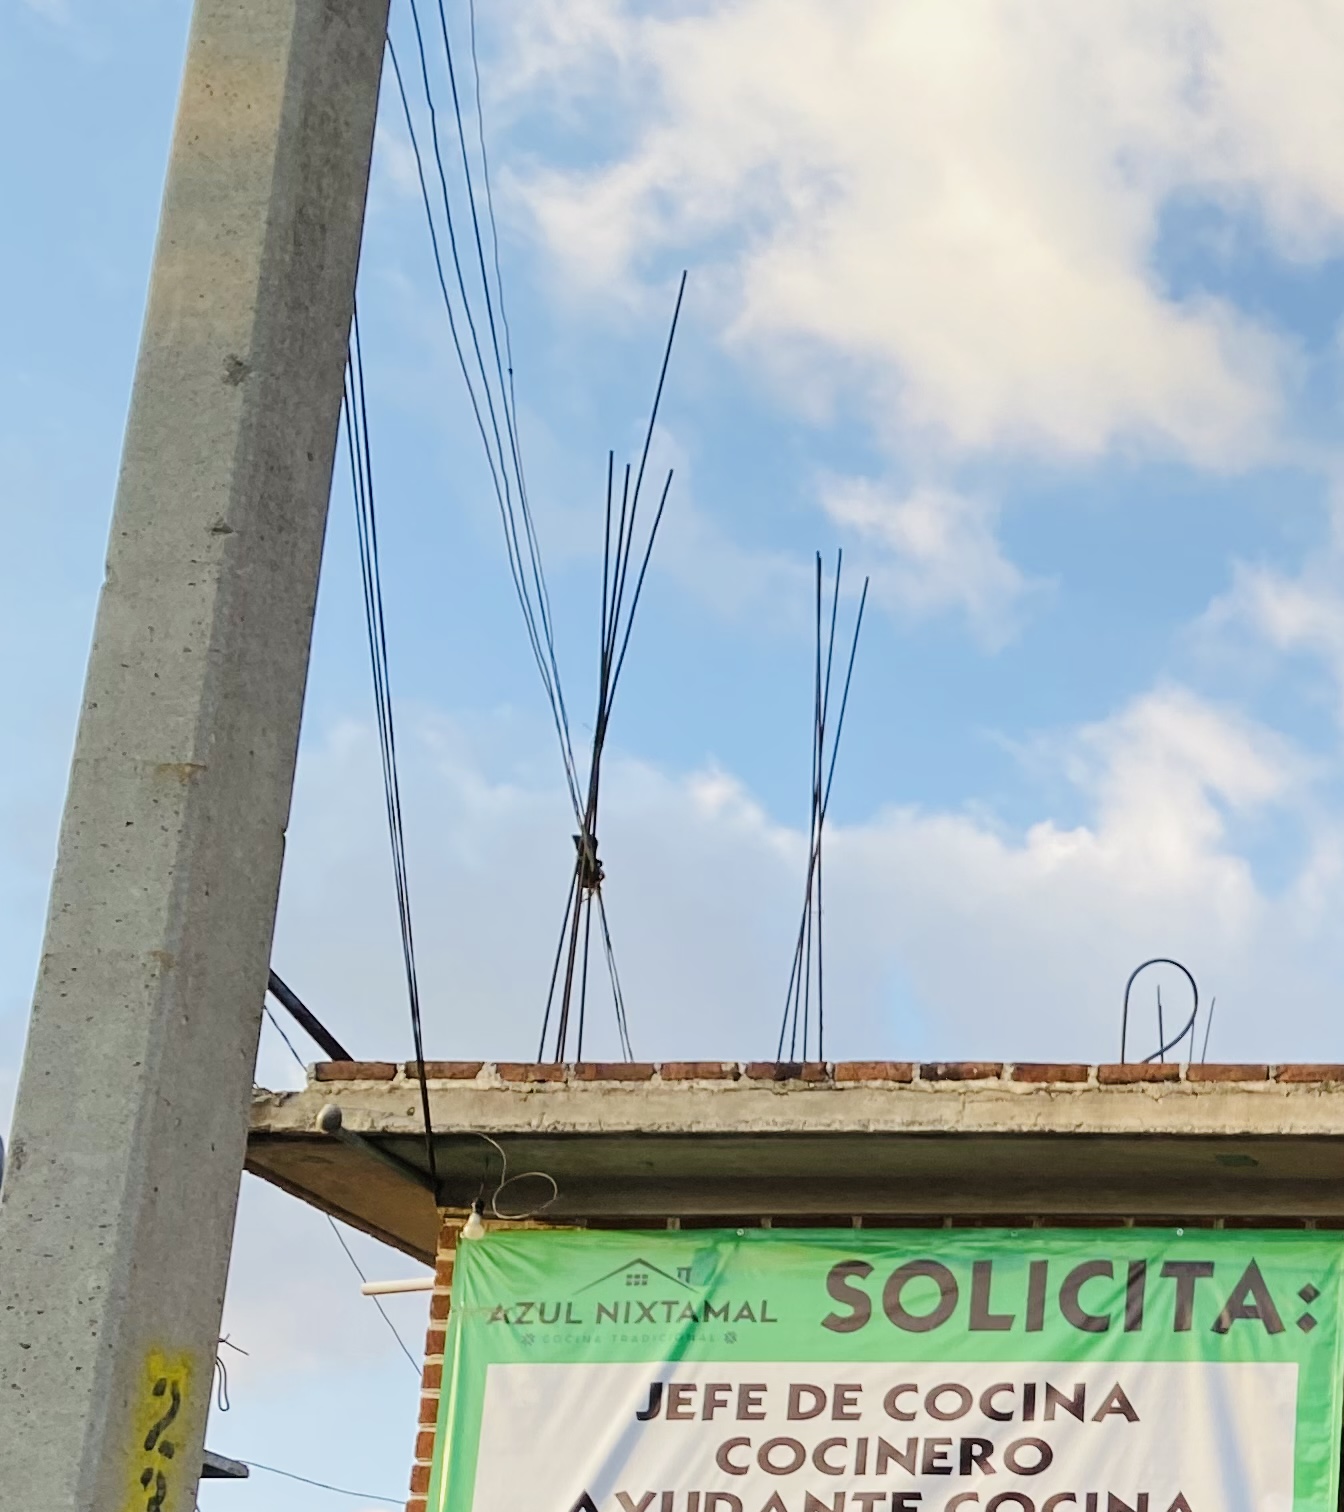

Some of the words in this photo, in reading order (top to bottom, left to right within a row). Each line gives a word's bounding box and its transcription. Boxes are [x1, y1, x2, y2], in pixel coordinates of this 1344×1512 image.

[486, 1301, 583, 1325] AZUL
[596, 1300, 778, 1325] NIXTAMAL
[821, 1258, 1322, 1335] SOLICITA:
[635, 1383, 768, 1421] JEFE
[786, 1383, 863, 1421] DE
[882, 1382, 1141, 1423] COCINA
[715, 1436, 1053, 1477] COCINERO
